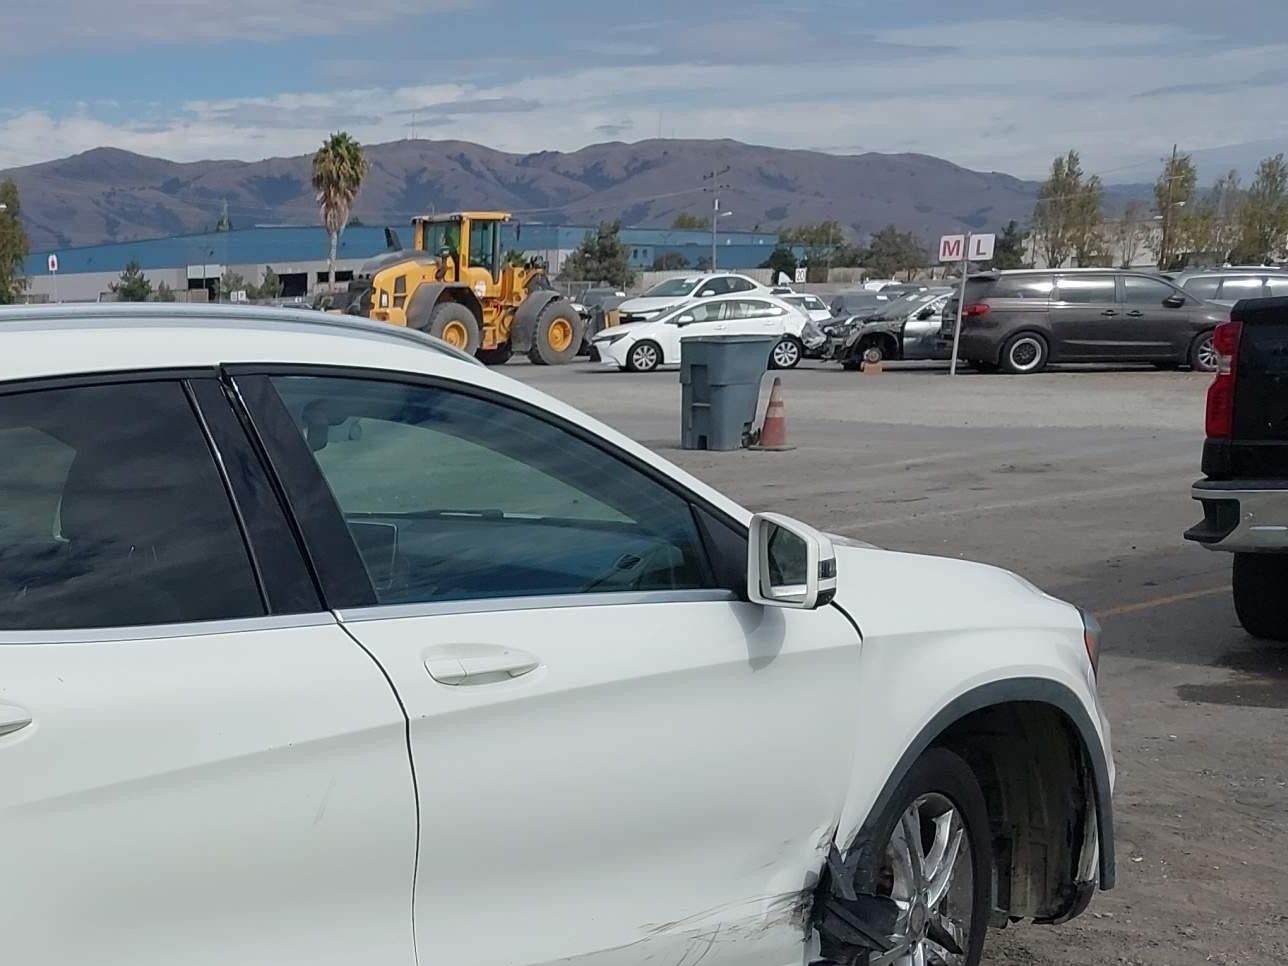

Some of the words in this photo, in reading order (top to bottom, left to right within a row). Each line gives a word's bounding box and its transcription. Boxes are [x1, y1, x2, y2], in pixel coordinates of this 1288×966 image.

[942, 239, 961, 256] M
[975, 239, 987, 256] L
[796, 270, 805, 281] 20
